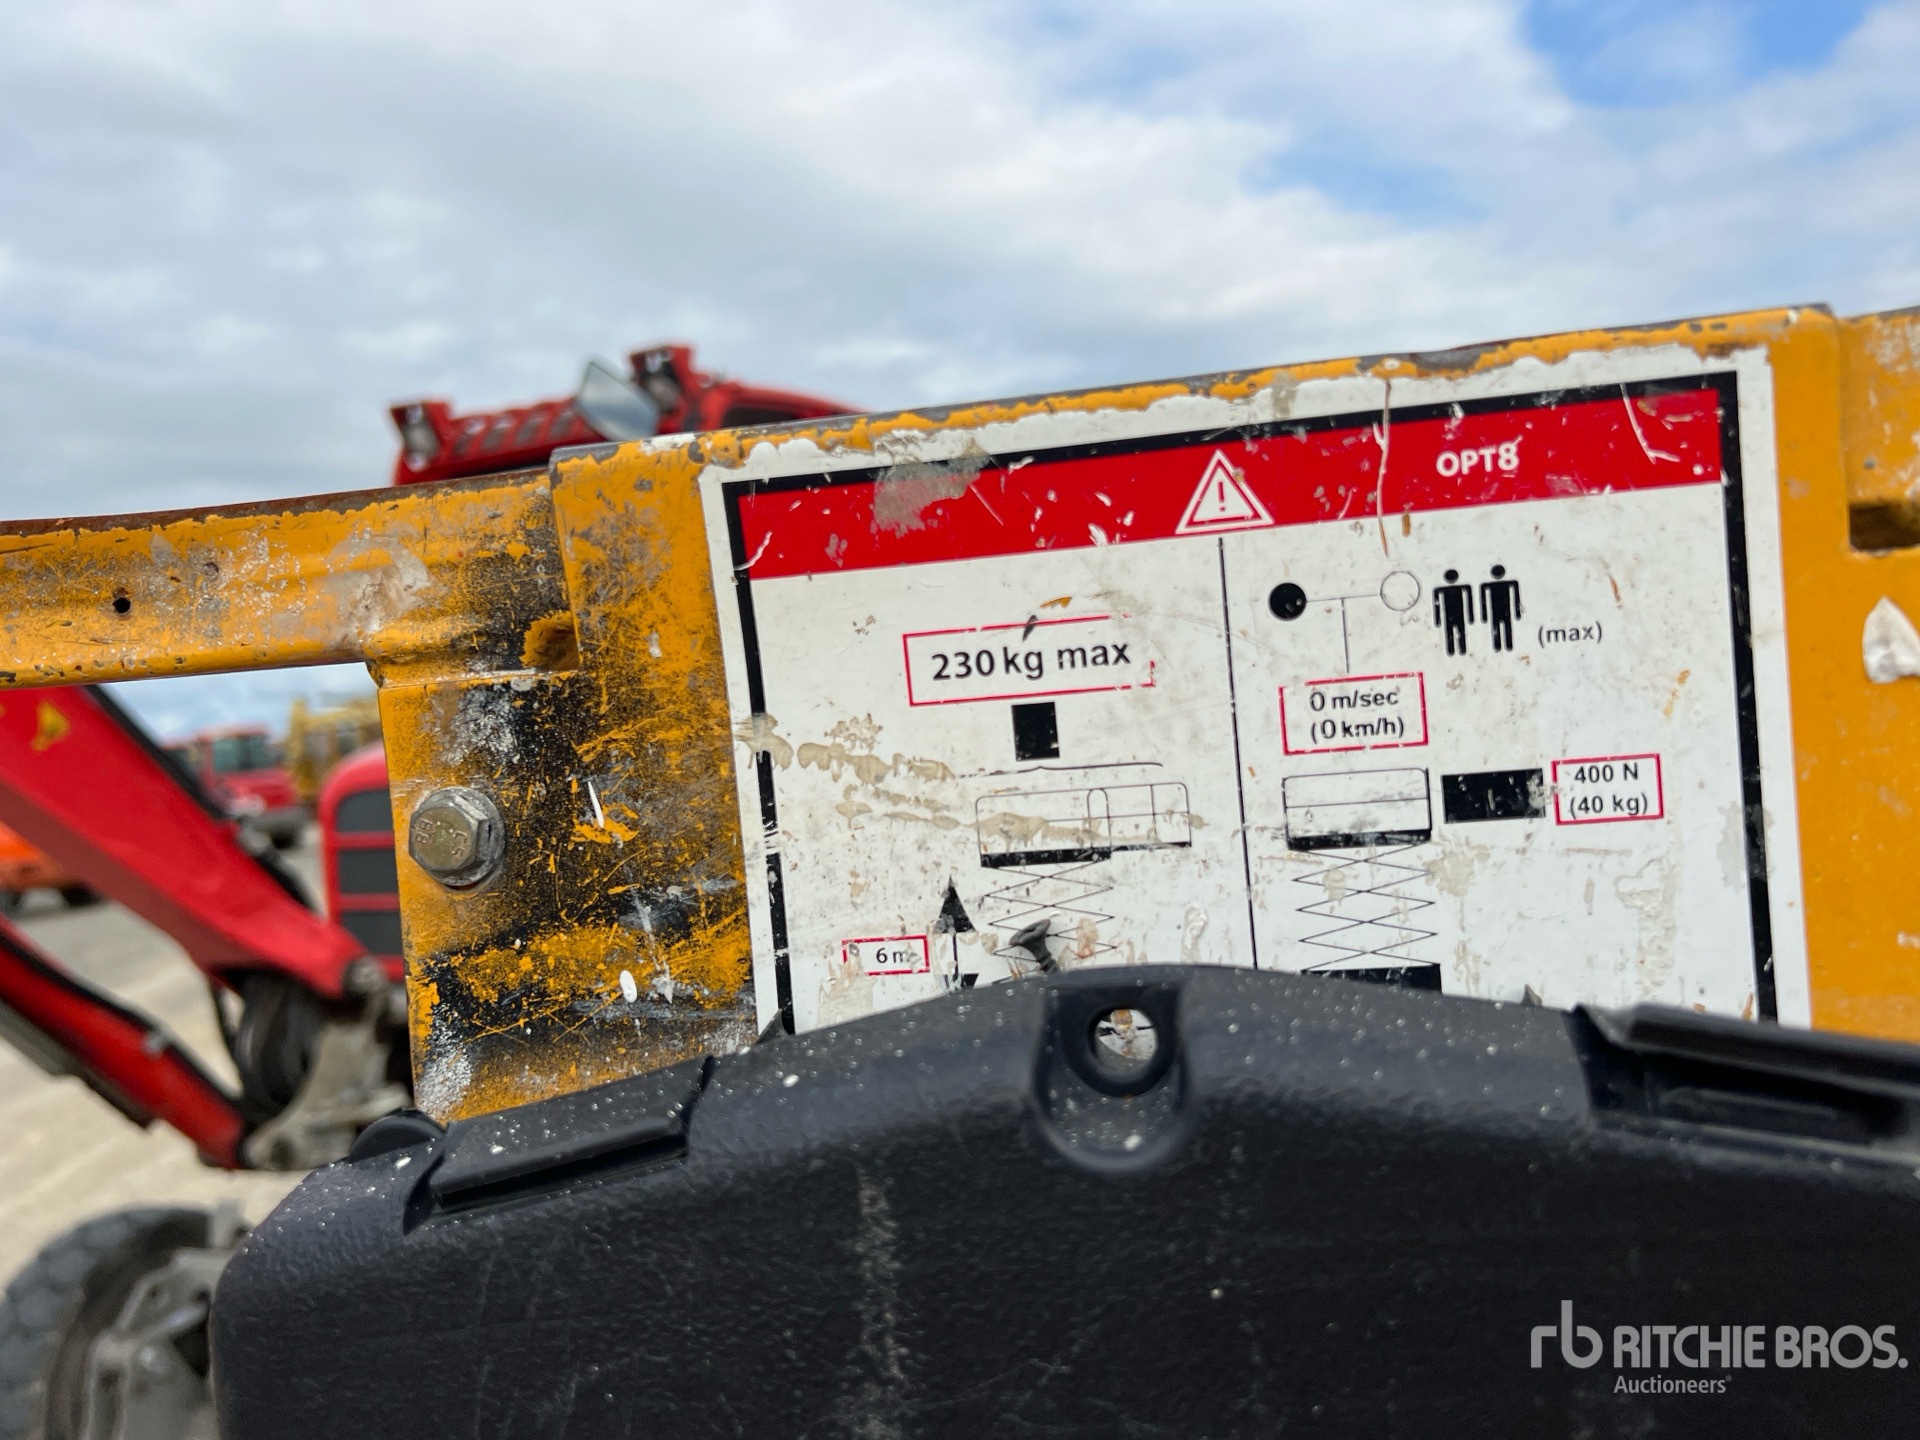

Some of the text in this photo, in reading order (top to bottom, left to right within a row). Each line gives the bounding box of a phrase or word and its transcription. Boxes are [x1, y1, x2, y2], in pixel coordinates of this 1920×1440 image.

[1436, 441, 1519, 477] OPT8
[1537, 621, 1602, 649] (max)
[931, 643, 1131, 681] 230 kg max
[1309, 690, 1399, 712] 0 m/sec
[1341, 716, 1404, 739] km/h)
[1574, 762, 1639, 784] 400 N
[1570, 792, 1648, 820] (40 kg)
[876, 947, 888, 964] 6
